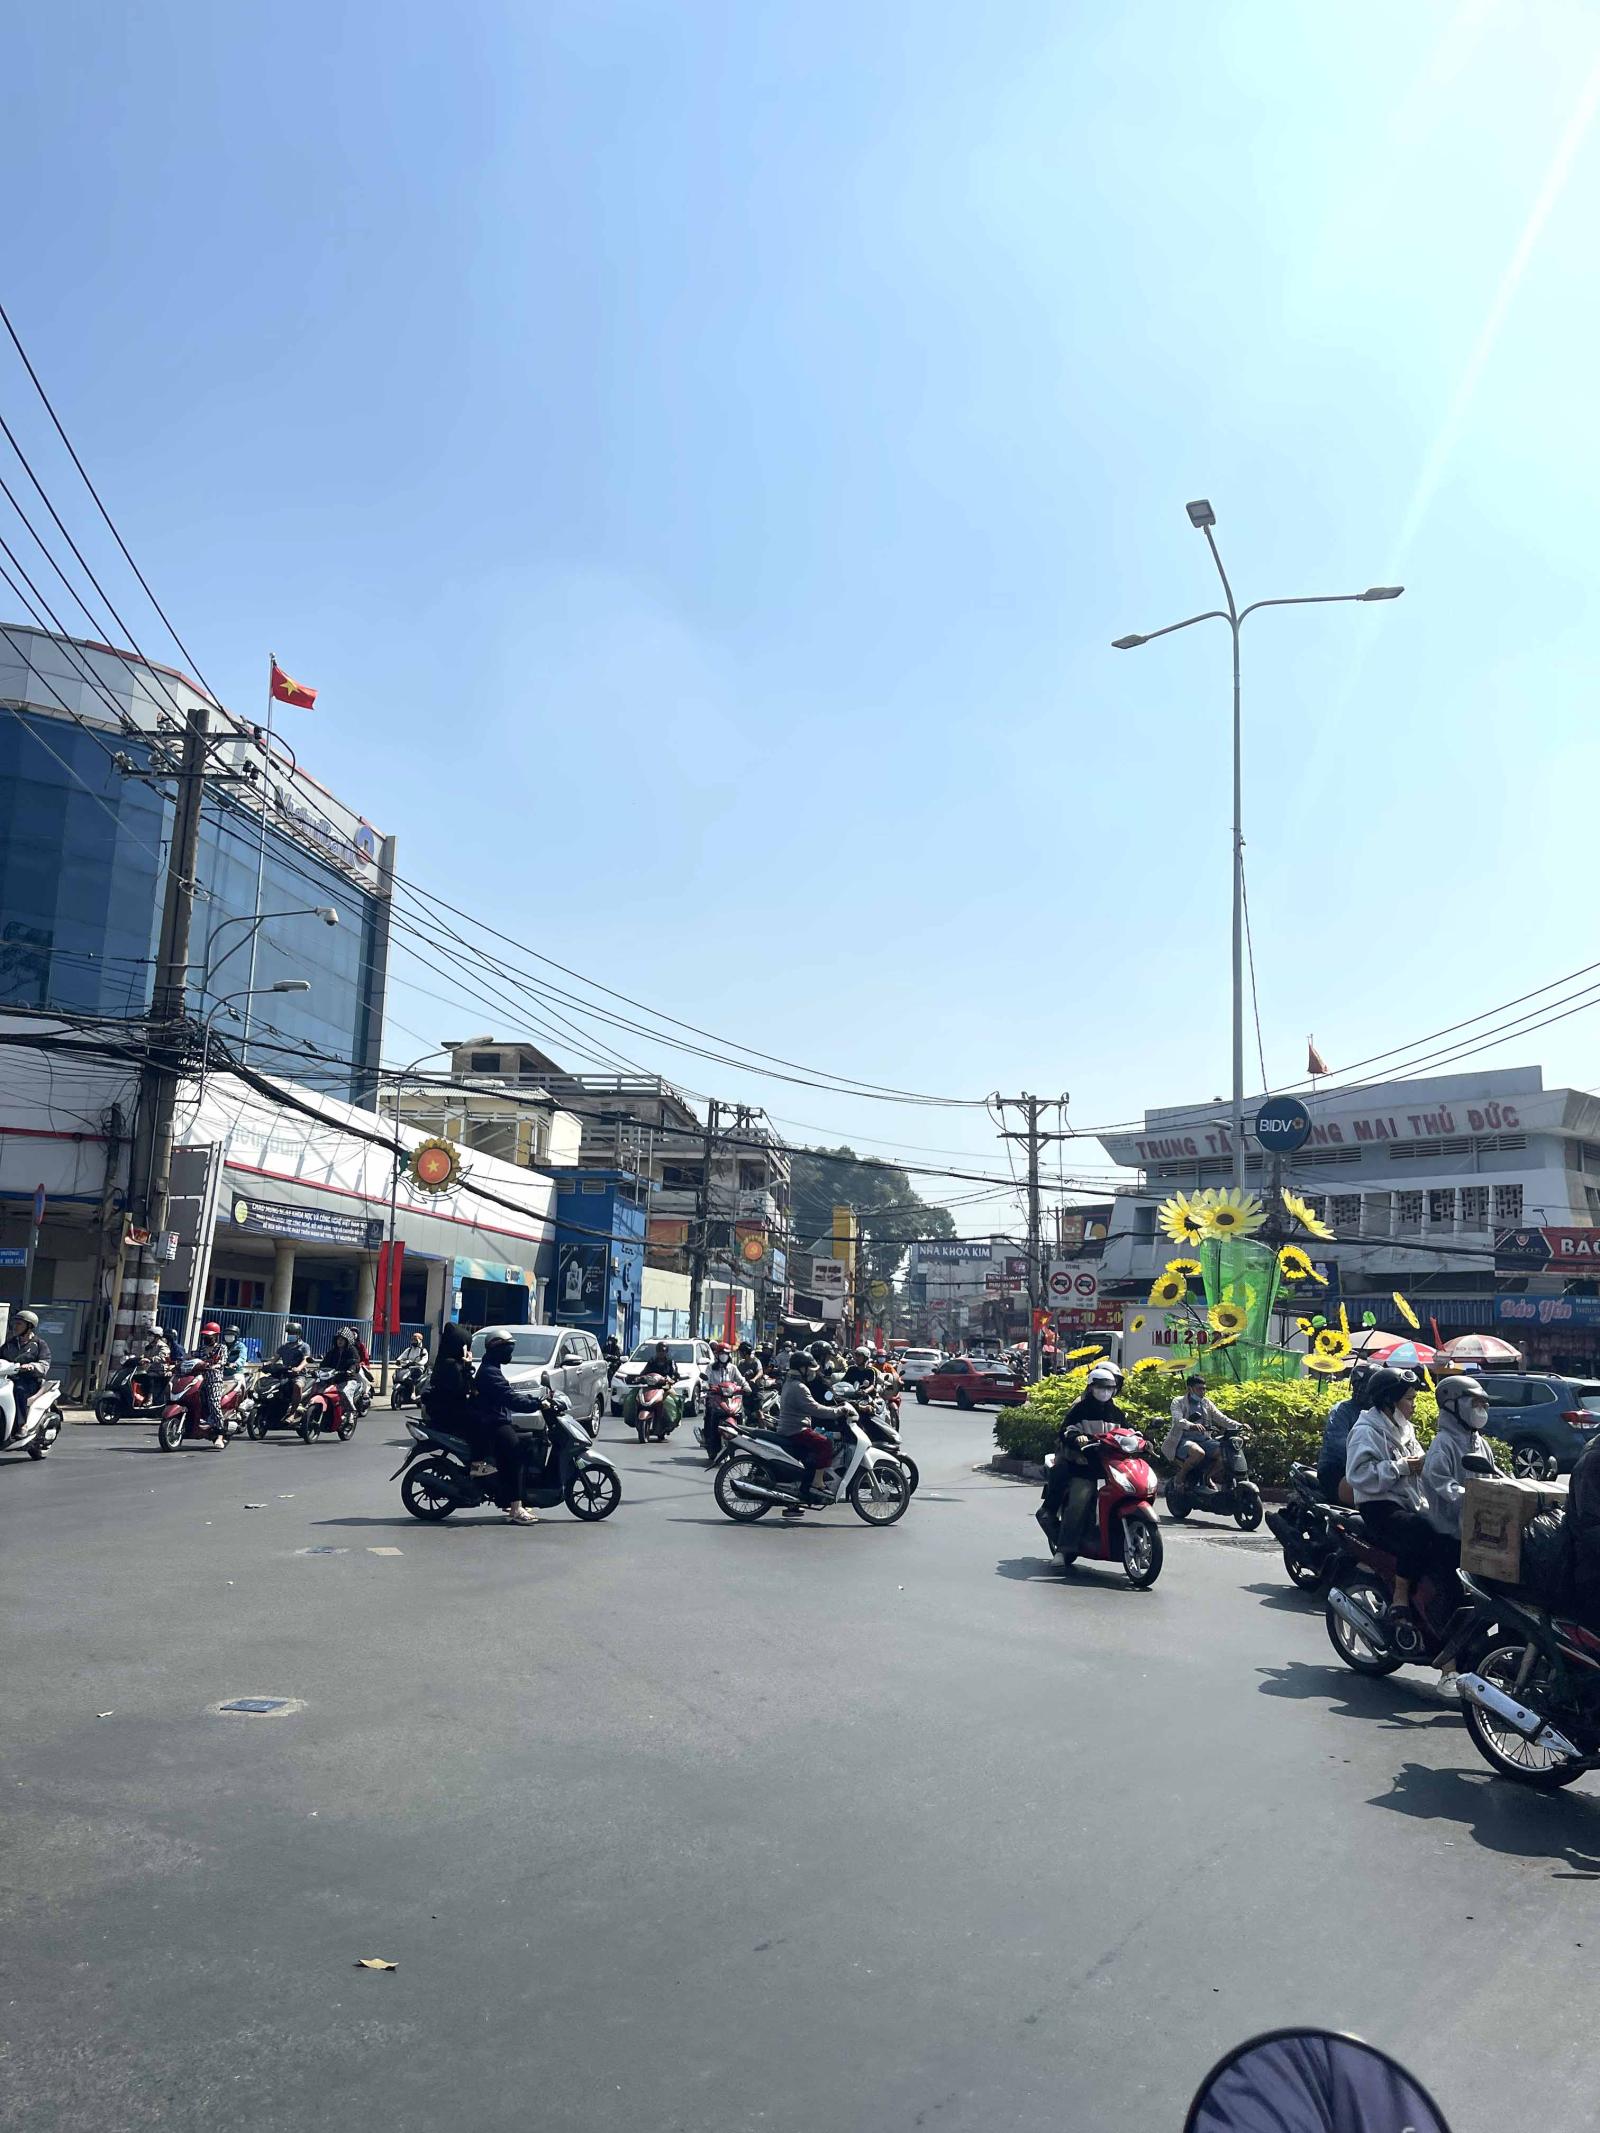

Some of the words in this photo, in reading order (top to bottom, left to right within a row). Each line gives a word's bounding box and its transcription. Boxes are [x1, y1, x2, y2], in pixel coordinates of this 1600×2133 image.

[1135, 1136, 1198, 1160] TRUNG
[1352, 1117, 1398, 1142] MẠI
[1408, 1104, 1455, 1136] THỦ
[1466, 1101, 1520, 1131] ĐỨC
[1260, 1119, 1292, 1132] BIDV
[920, 1246, 940, 1256] NHA
[942, 1246, 970, 1256] KHOA
[973, 1248, 990, 1257] KIM
